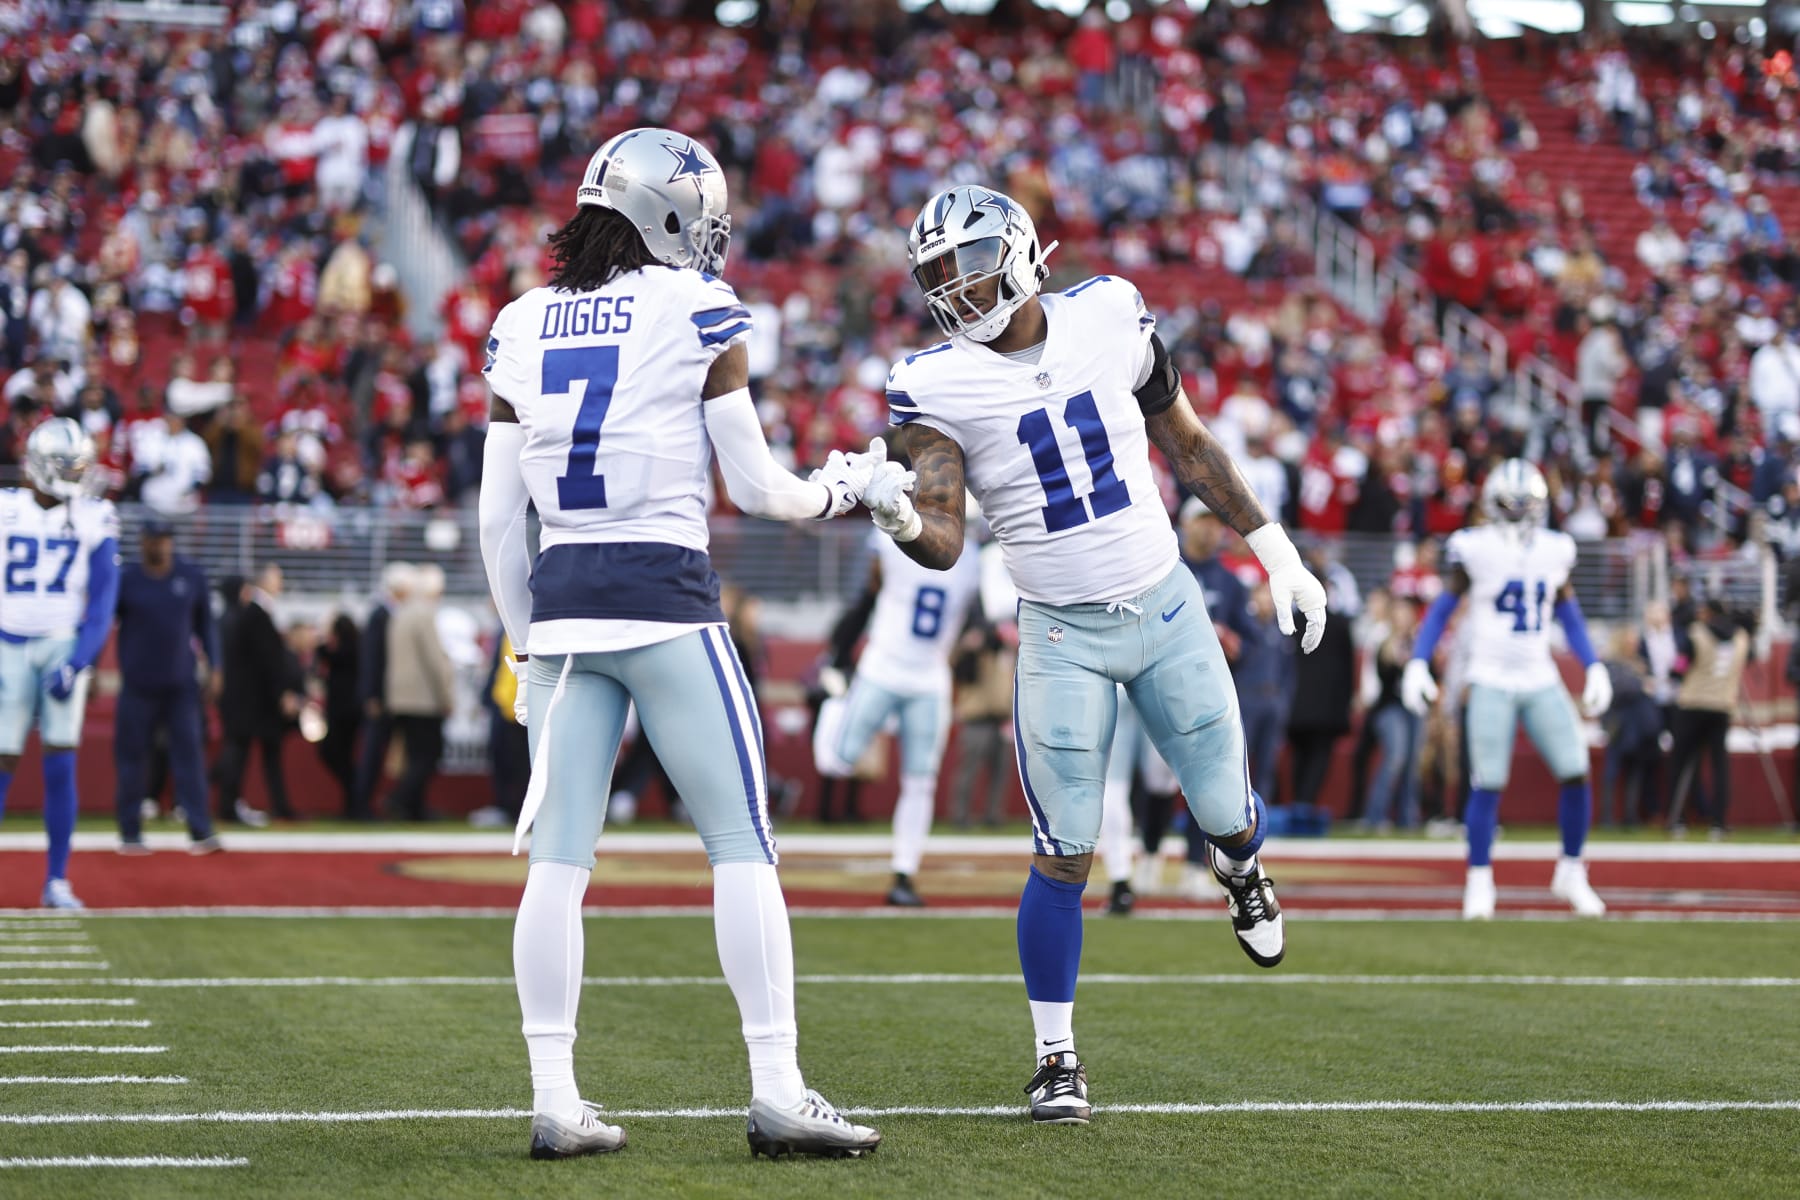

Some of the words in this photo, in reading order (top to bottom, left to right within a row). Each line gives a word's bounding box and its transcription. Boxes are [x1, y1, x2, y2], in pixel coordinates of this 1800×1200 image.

[540, 296, 634, 339] DIGGS
[541, 345, 620, 511] 7
[1016, 389, 1132, 533] 11
[5, 535, 80, 594] 27
[911, 585, 948, 641] 8
[1494, 580, 1547, 632] 41
